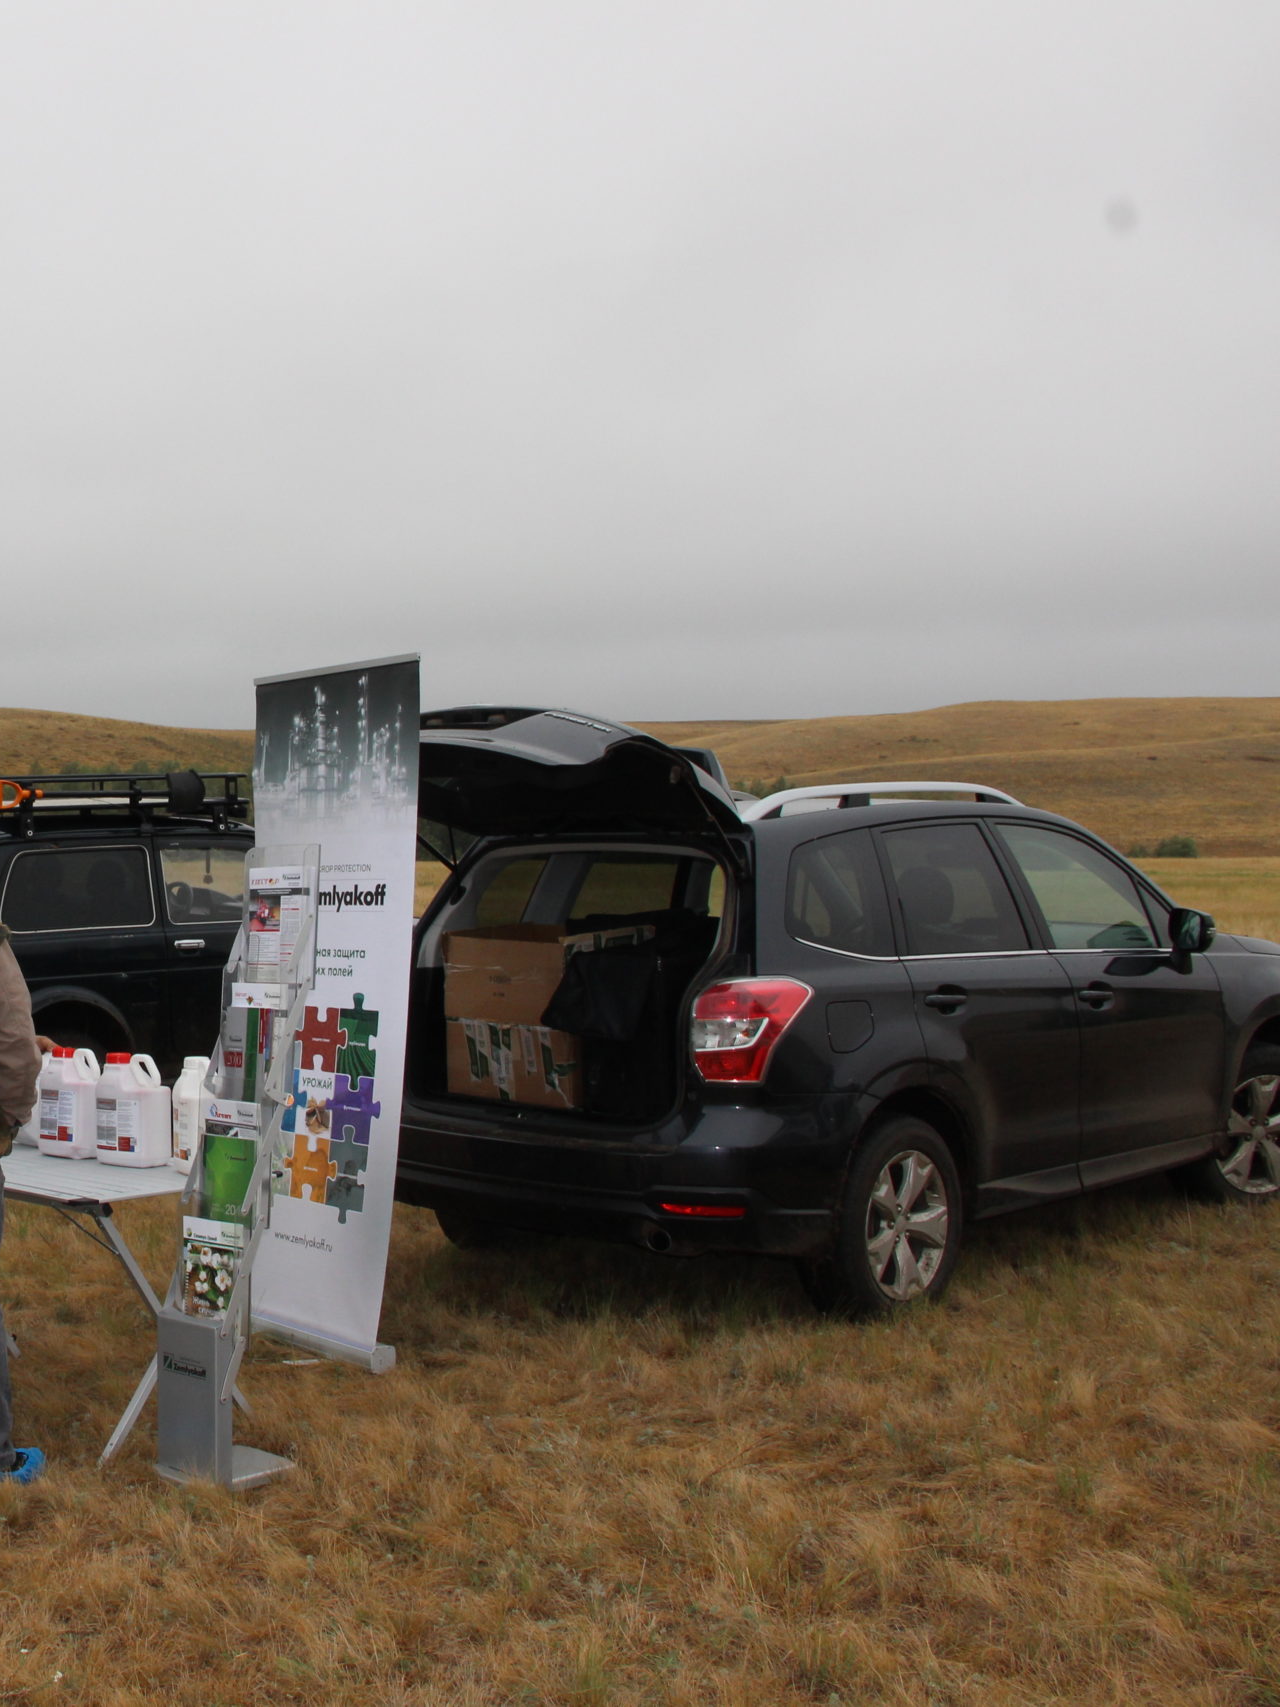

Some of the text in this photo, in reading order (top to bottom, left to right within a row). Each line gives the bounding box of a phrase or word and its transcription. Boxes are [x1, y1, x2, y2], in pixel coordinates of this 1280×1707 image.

[334, 864, 371, 873] PROTECTION
[332, 949, 366, 960] защита
[327, 964, 353, 977] полей
[302, 1077, 333, 1089] УРОЖАЙ
